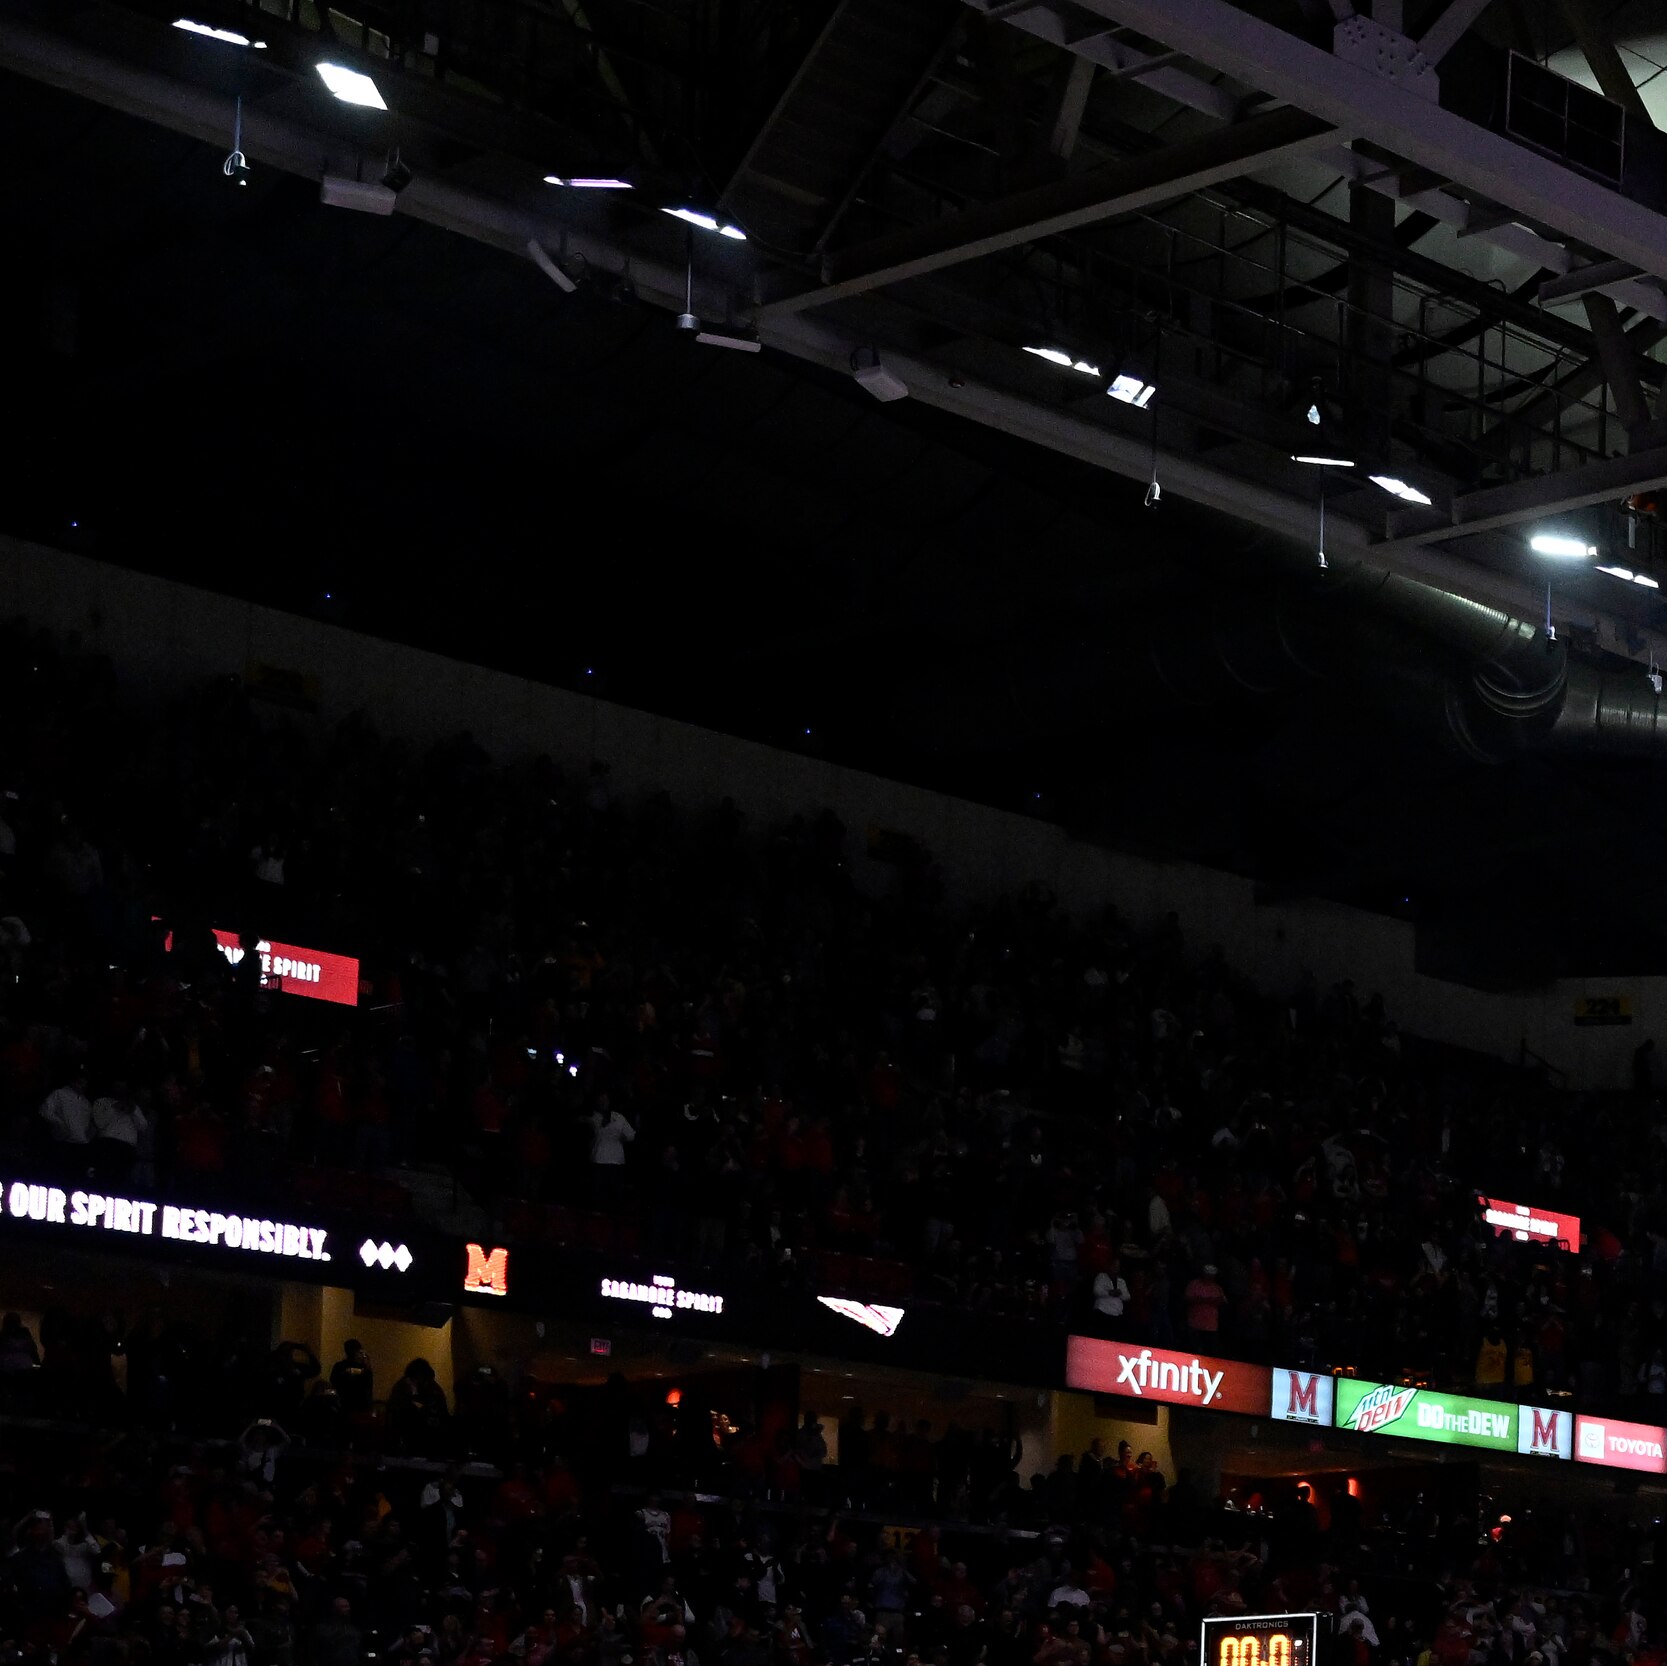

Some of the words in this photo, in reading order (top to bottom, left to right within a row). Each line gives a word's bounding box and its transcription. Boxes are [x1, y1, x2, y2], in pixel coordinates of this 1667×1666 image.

[273, 956, 321, 983] SPIRIT
[9, 1182, 66, 1224] OUR
[71, 1192, 156, 1235] SPIRIT
[162, 1204, 330, 1261] RESPONSIBLY.
[466, 1243, 508, 1289] M
[602, 1278, 674, 1306] SAGAMORE
[676, 1290, 723, 1313] SPIRIT
[1116, 1349, 1224, 1404] xfinity
[1287, 1370, 1320, 1417] M
[1418, 1402, 1444, 1429] DO
[1444, 1413, 1468, 1432] THE
[1531, 1408, 1560, 1451] M
[1609, 1436, 1663, 1457] TOYOTA
[1236, 1621, 1288, 1630] DAKTRONICS
